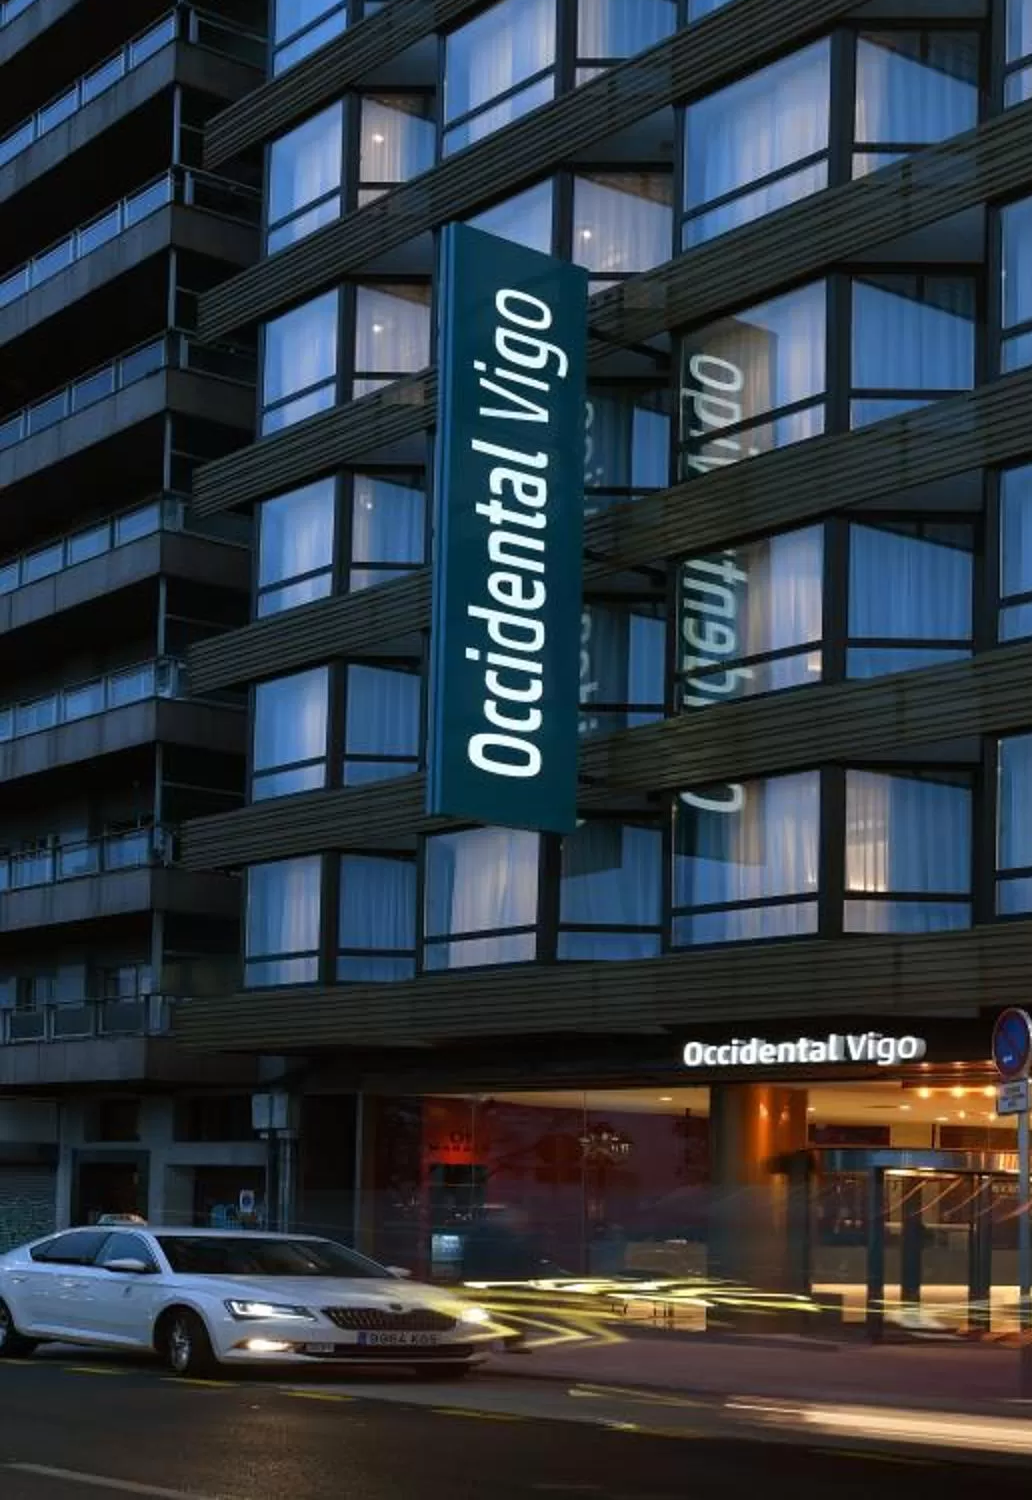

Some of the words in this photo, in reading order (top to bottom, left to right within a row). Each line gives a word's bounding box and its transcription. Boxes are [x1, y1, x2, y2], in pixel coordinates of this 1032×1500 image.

[473, 288, 568, 423] Vigo
[465, 438, 549, 778] Occidental
[683, 1034, 841, 1067] Occidental
[845, 1031, 922, 1066] Vigo
